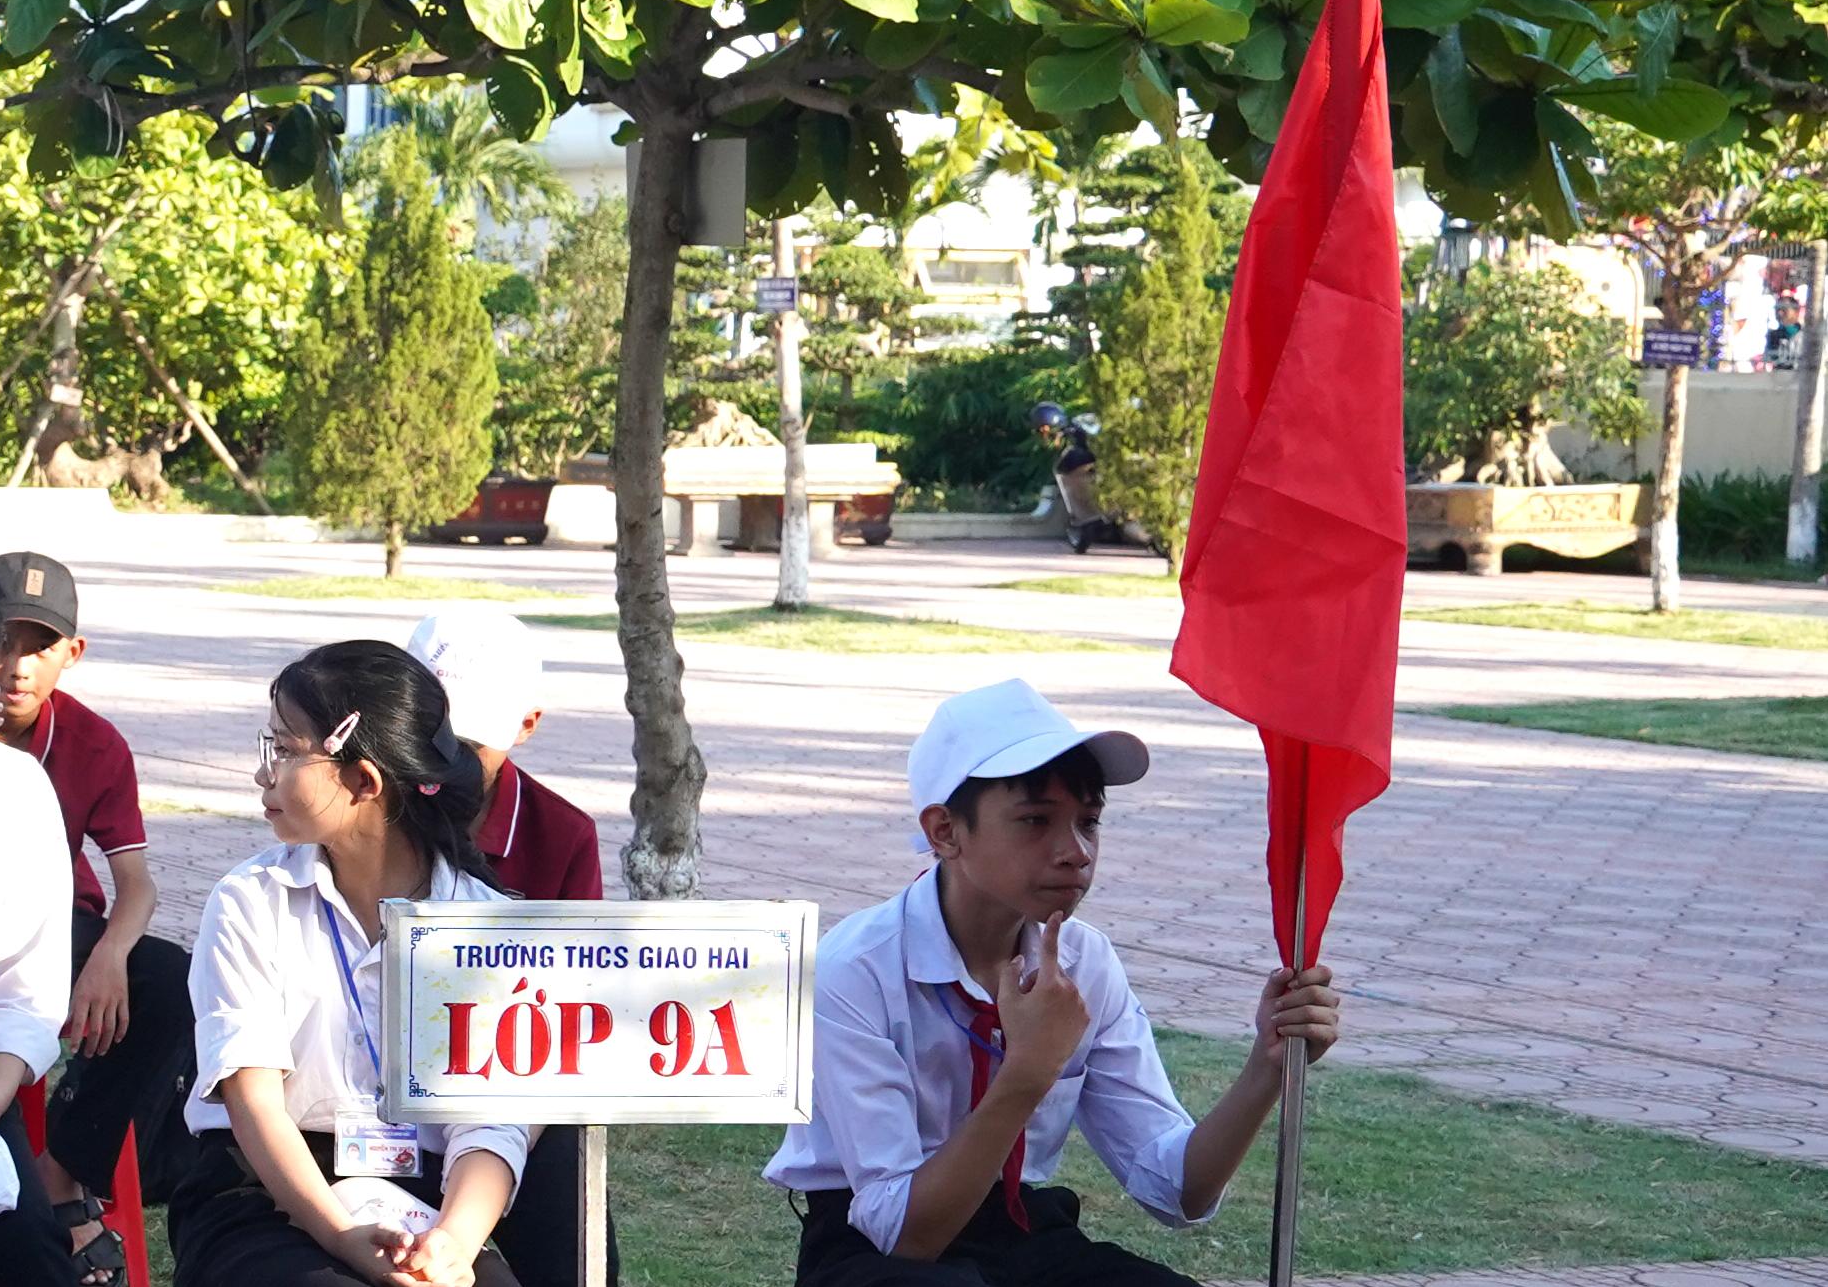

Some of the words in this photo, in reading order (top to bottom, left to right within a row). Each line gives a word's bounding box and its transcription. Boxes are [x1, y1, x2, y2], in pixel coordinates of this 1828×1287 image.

[453, 939, 555, 970] TRƯỜNG
[564, 945, 629, 970] THCS
[639, 946, 697, 970] GIAO
[442, 976, 614, 1082] LỚP
[649, 999, 752, 1078] 9A
